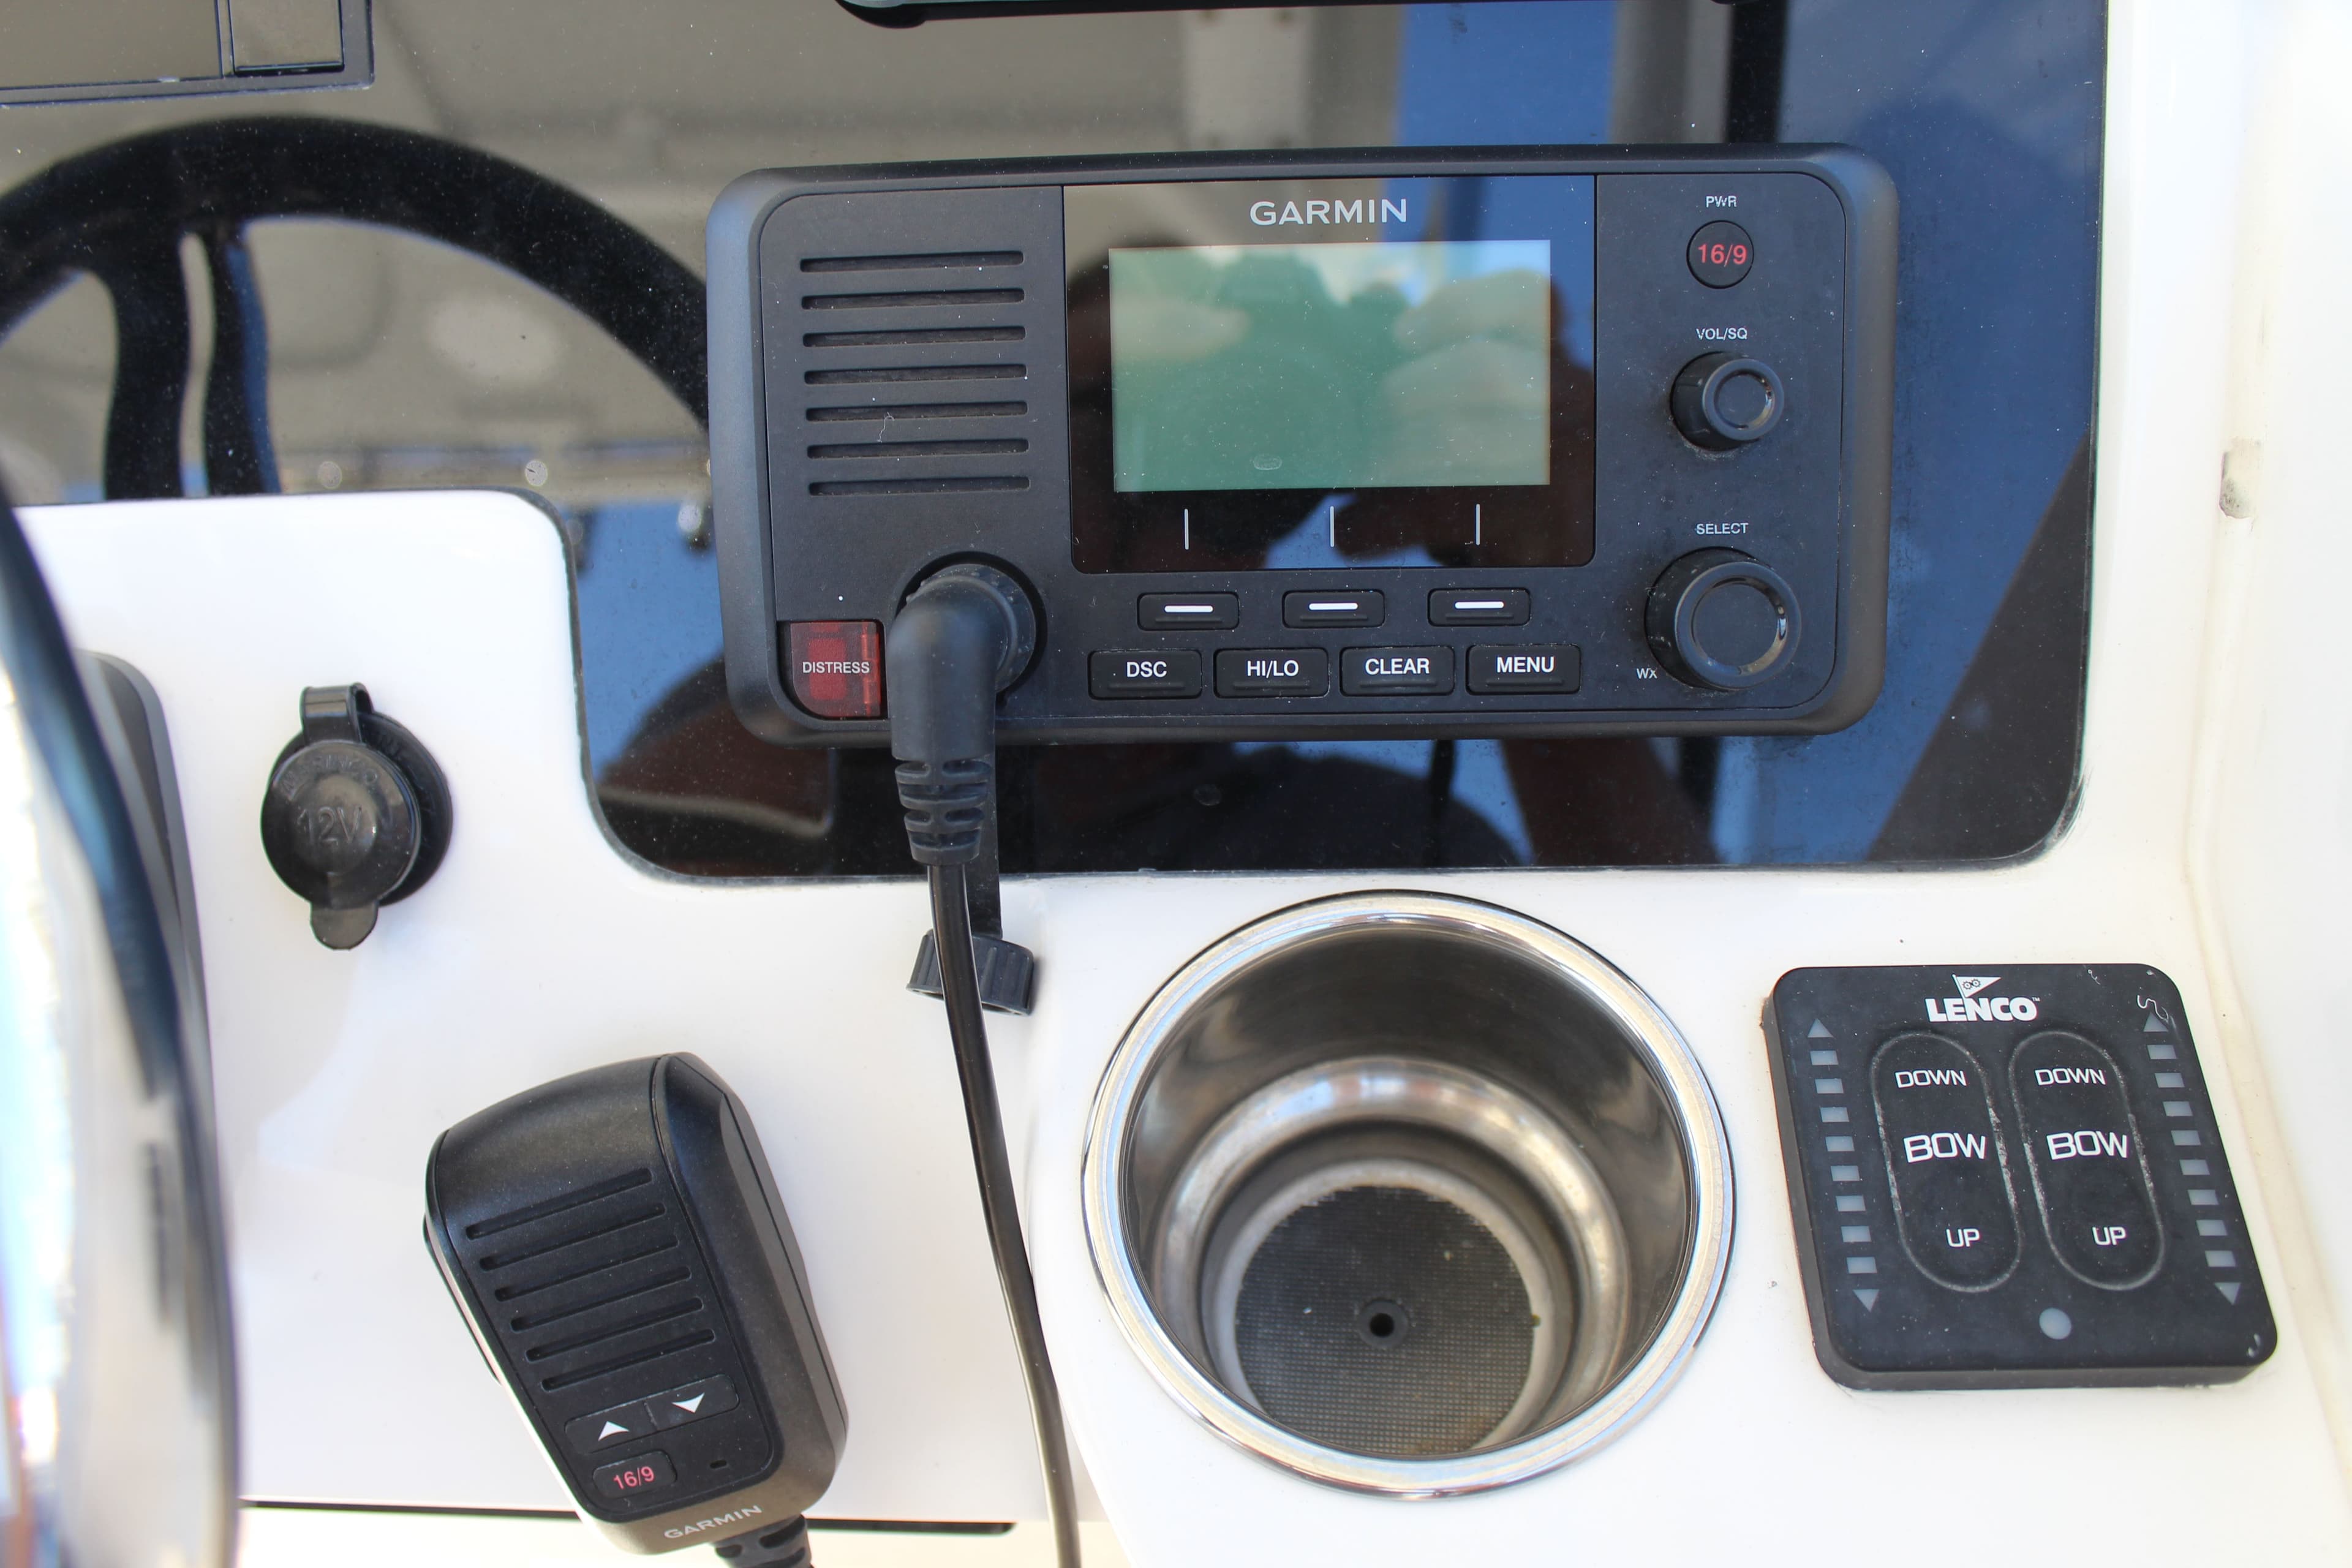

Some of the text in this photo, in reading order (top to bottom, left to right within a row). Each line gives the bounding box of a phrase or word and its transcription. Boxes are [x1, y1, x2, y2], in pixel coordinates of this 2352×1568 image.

[1706, 195, 1737, 208] PWR
[1249, 198, 1408, 226] GARMIN
[1698, 243, 1747, 266] 16/9
[1696, 327, 1747, 341] VOL/SQ
[1696, 522, 1749, 535] SELECT
[802, 661, 870, 674] DISTRESS
[1126, 661, 1167, 678] DSC
[1247, 660, 1299, 679] HI/LO
[1365, 658, 1430, 675] CLEAR
[1496, 656, 1555, 673] MENU
[1636, 668, 1657, 679] WX
[298, 804, 362, 846] 12V
[1894, 1069, 1967, 1088] DOWN
[2035, 1068, 2106, 1086] DOWN
[1903, 1132, 1986, 1163] BOW
[2046, 1130, 2128, 1161] BOW
[1946, 1228, 1980, 1248] UP
[2092, 1226, 2127, 1246] UP
[613, 1465, 655, 1490] 16/9
[664, 1505, 763, 1540] GARMIN
